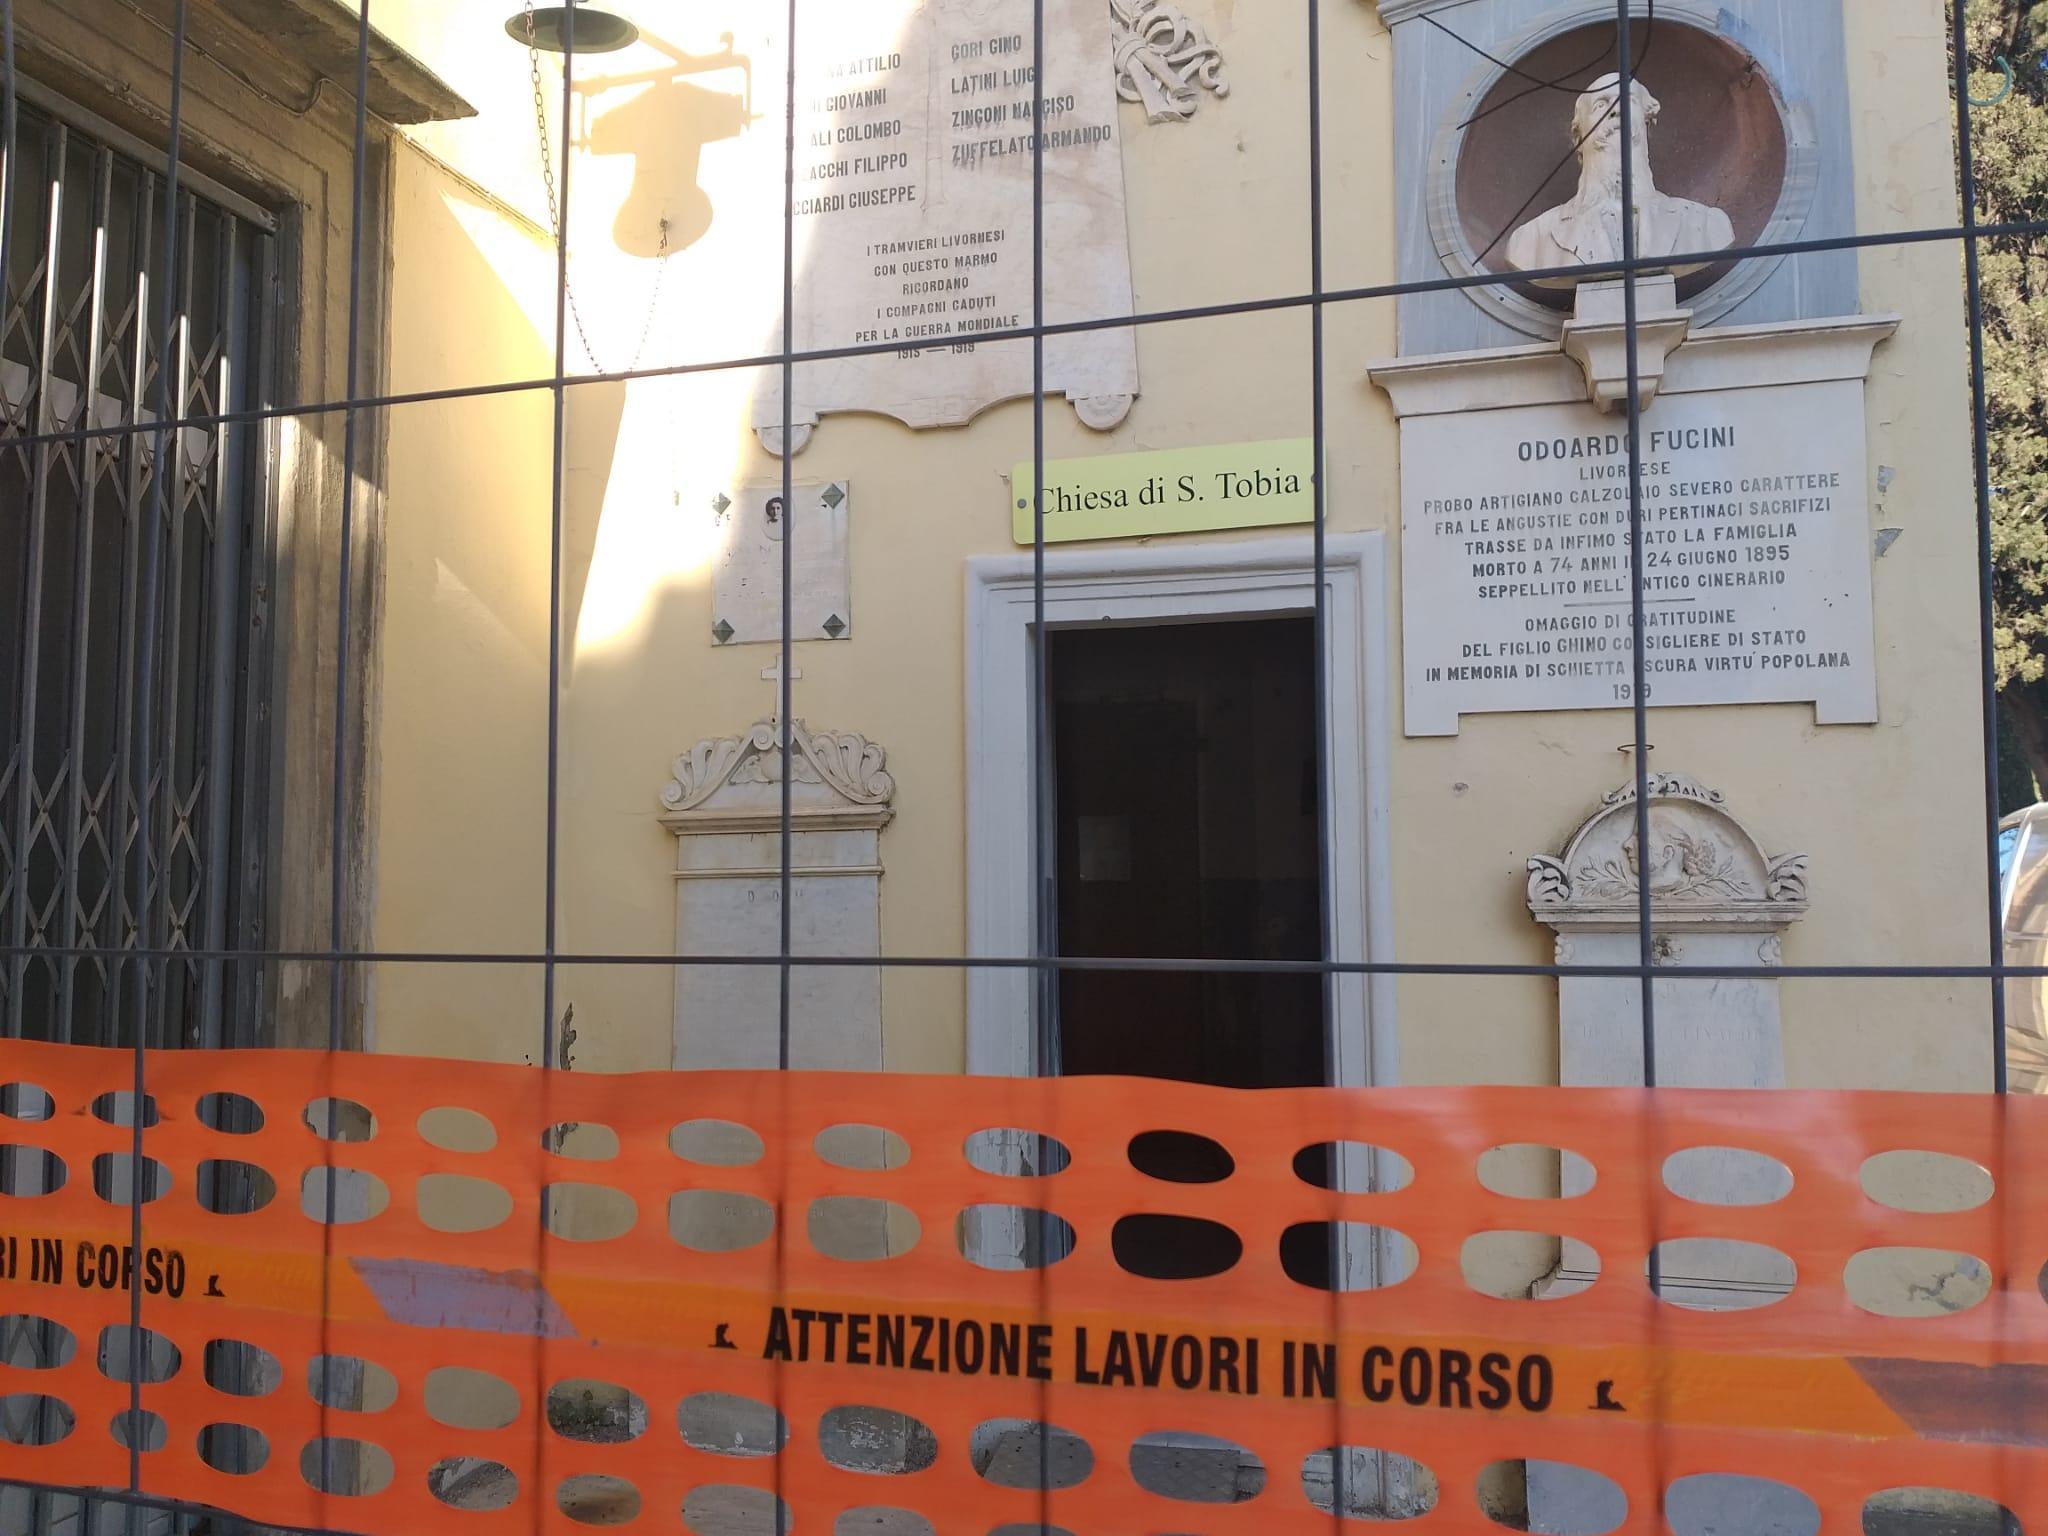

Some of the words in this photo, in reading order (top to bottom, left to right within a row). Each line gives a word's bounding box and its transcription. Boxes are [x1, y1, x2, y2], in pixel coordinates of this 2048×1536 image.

[951, 40, 983, 61] GORI
[989, 35, 1021, 54] GINO
[951, 73, 997, 95] LATINI
[826, 88, 887, 112] GIOVANNI
[951, 103, 1007, 128] ZINGONI
[1012, 95, 1075, 120] NACISO
[837, 119, 901, 144] COLOMBO
[951, 137, 1035, 164] ZUFFELATO
[1042, 125, 1111, 150] ARMANDO
[854, 152, 908, 175] FILIPPO
[849, 185, 916, 209] GIUSEPPE
[874, 236, 938, 256] TRAMVIERI
[941, 229, 1006, 249] LIVORNESI
[874, 264, 897, 278] CON
[902, 257, 949, 275] QUESTO
[954, 252, 998, 269] MARMO
[902, 276, 969, 296] RICORDANO
[886, 301, 947, 318] COMPAGNI
[952, 295, 996, 312] CADUTI
[855, 329, 878, 344] PER
[884, 328, 899, 341] LA
[905, 321, 951, 339] GUERRA
[957, 314, 1020, 333] MONDIALE
[1651, 426, 1735, 452] FUCINI
[1034, 484, 1129, 515] Chiesa
[1139, 477, 1165, 505] di
[1177, 475, 1204, 503] S.
[1215, 467, 1301, 500] Tobia
[1424, 498, 1473, 515] PROBO
[1480, 491, 1563, 511] ARTIGIANO
[1669, 480, 1733, 497] SEVERO
[1741, 472, 1840, 493] CARATTERE
[1435, 522, 1464, 536] FRA
[1471, 518, 1489, 532] LE
[1497, 513, 1572, 531] ANGUSTIE
[1579, 511, 1609, 526] CON
[1659, 502, 1743, 521] PERTINACI
[1750, 496, 1831, 516] SACRIFIZI
[1465, 539, 1526, 556] TRASSE
[1534, 536, 1553, 551] DA
[1561, 533, 1615, 550] INFIMO
[1624, 530, 1677, 546] SATO
[1685, 527, 1704, 542] LA
[1714, 522, 1797, 541] FAMIGLIA
[1473, 561, 1526, 577] MORTO
[1533, 560, 1543, 574] A
[1550, 556, 1573, 573] 74
[1580, 555, 1616, 572] ANNI
[1647, 551, 1672, 568] 24
[1678, 549, 1737, 566] GIUGNO
[1746, 545, 1790, 562] 1895
[1478, 579, 1576, 599] SEPPELLITO
[1698, 569, 1786, 588] CINERARIO
[1525, 615, 1597, 632] OMAGGIO
[1604, 614, 1620, 629] DI
[1462, 643, 1493, 658] DEL
[1499, 640, 1551, 657] FIGLIO
[1557, 636, 1607, 654] GHINO
[1612, 633, 1720, 652] COSIGLIERE
[1728, 632, 1744, 647] DI
[1751, 629, 1806, 647] STATO
[1426, 668, 1441, 682] IN
[1447, 664, 1518, 682] MEMORIA
[1525, 663, 1540, 679] DI
[1547, 660, 1625, 678] SCHIETTA
[1634, 656, 1697, 673] SCURA
[1761, 652, 1850, 670] POPOLANA
[1612, 683, 1652, 700] 199
[31, 1238, 63, 1285] IN
[76, 1241, 186, 1299] CORSO
[763, 1306, 1054, 1382] ATTENZIONE
[1074, 1326, 1259, 1396] LAVORI
[1282, 1340, 1337, 1400] IN
[1361, 1345, 1554, 1413] CORSO
